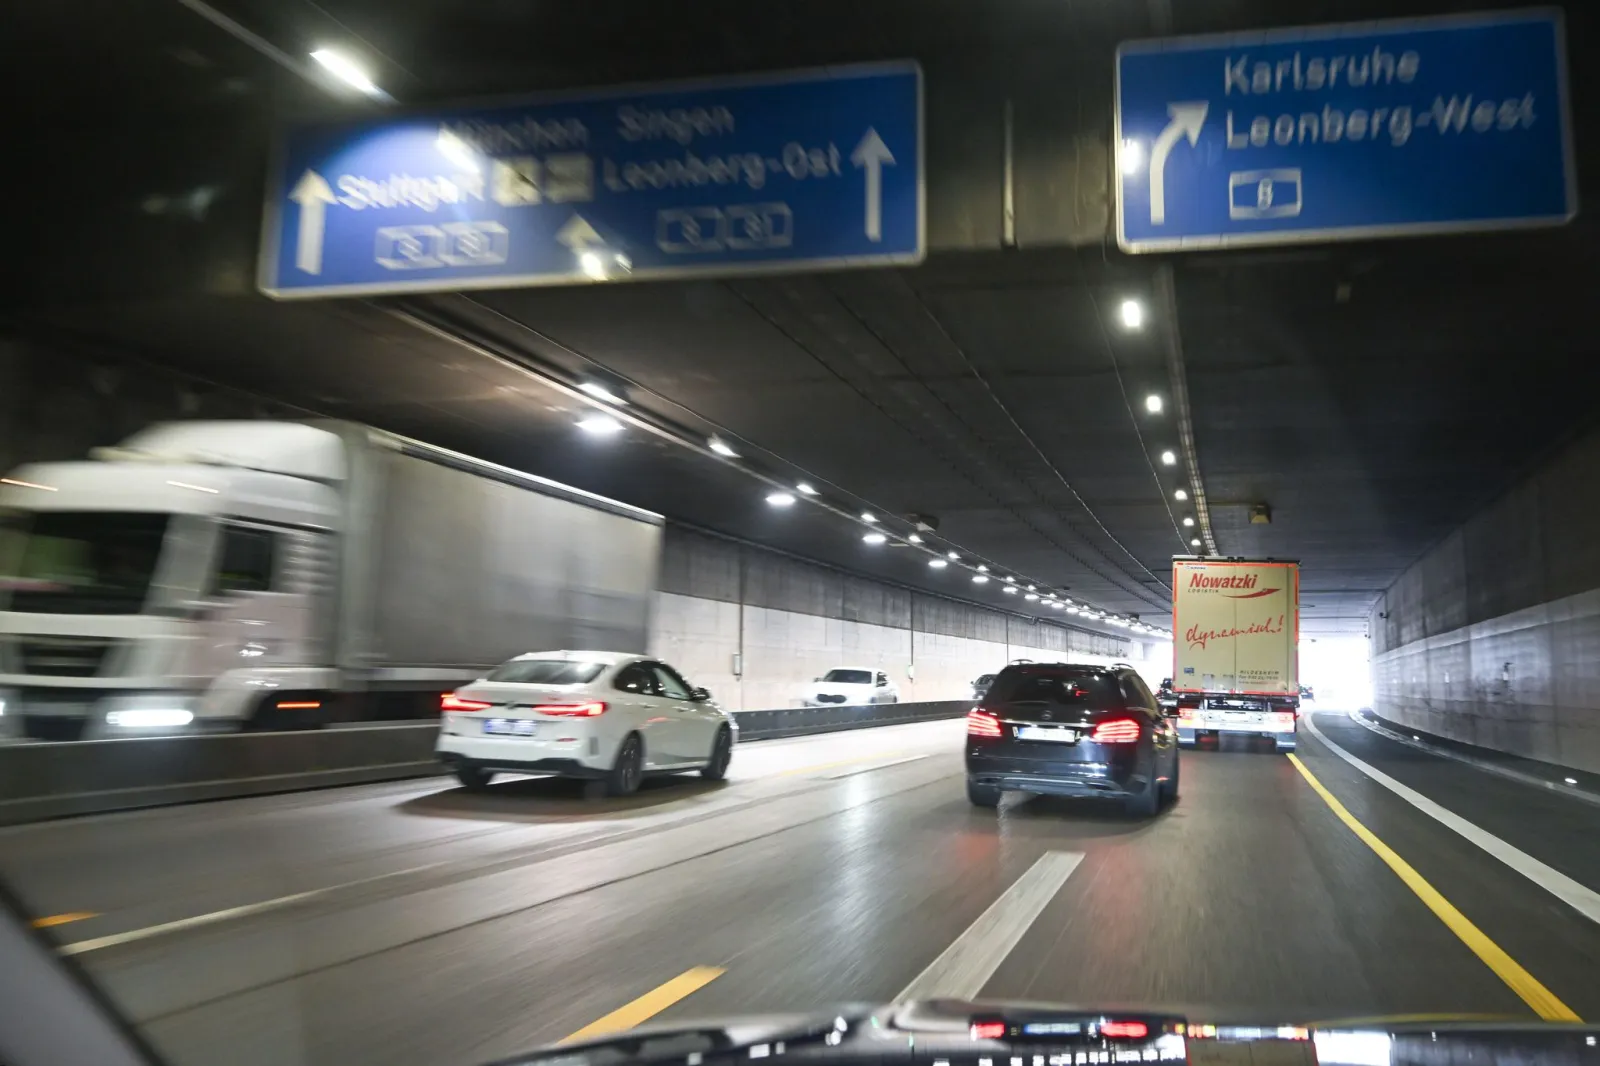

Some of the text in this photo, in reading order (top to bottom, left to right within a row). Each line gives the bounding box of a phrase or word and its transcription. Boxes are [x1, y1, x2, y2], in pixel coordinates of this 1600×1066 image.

[1224, 45, 1420, 96] Karlsruhe
[617, 104, 734, 145] Singen
[1227, 92, 1536, 149] Leonberg-West
[603, 141, 841, 191] Leonberg-Ost
[1189, 573, 1258, 589] Nowatzki
[1186, 615, 1284, 650] dynamisch!
